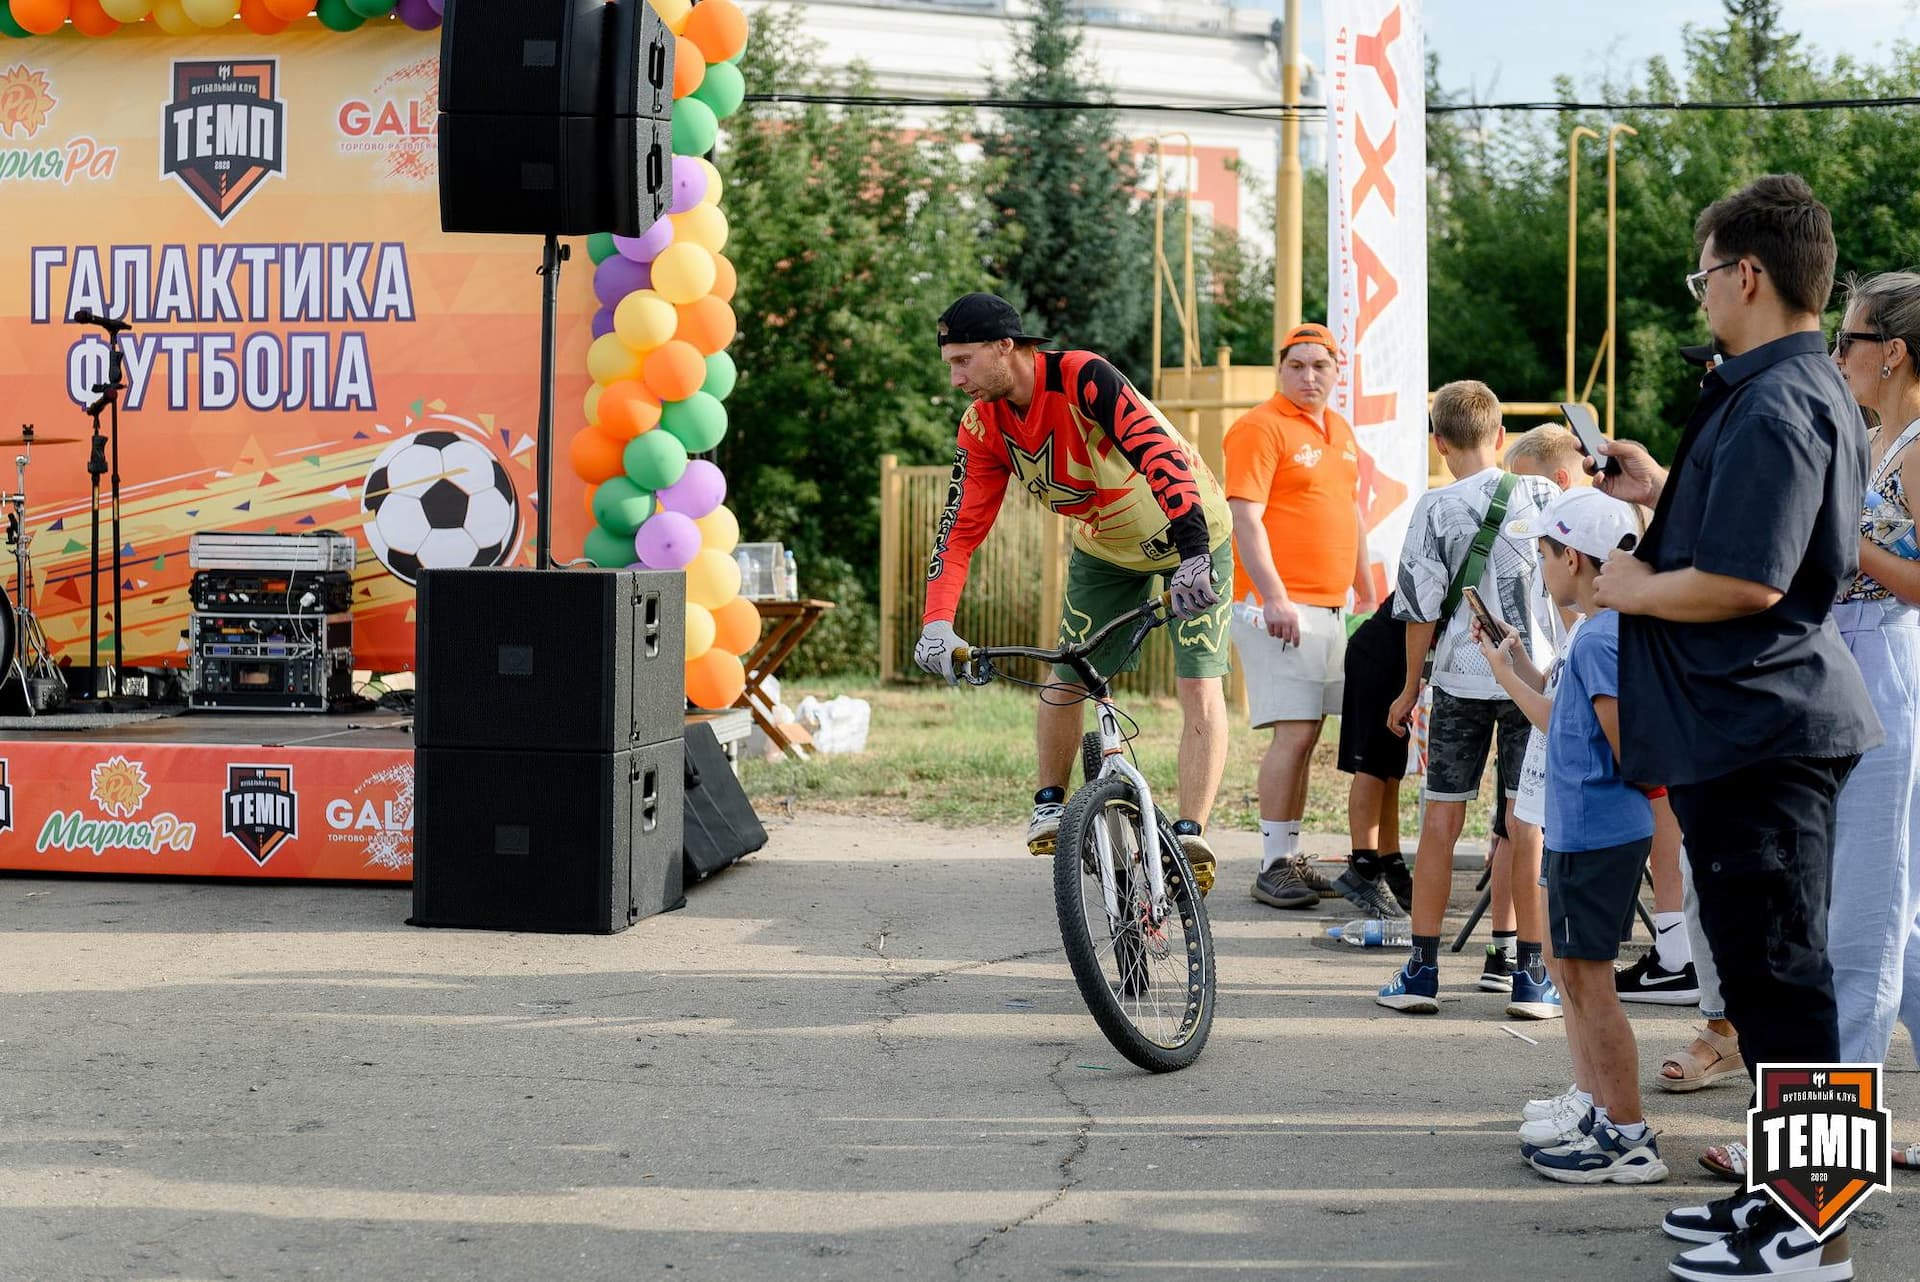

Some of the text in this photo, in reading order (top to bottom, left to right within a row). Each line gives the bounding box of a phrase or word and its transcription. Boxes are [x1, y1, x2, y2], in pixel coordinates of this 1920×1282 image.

[173, 103, 275, 161] ТЕМП
[214, 160, 231, 170] 2020
[31, 243, 416, 323] ГАЛАКТИКА
[67, 331, 377, 411] ФУТБОЛА
[37, 811, 195, 853] МарияРа
[229, 792, 291, 829] ТЕМП
